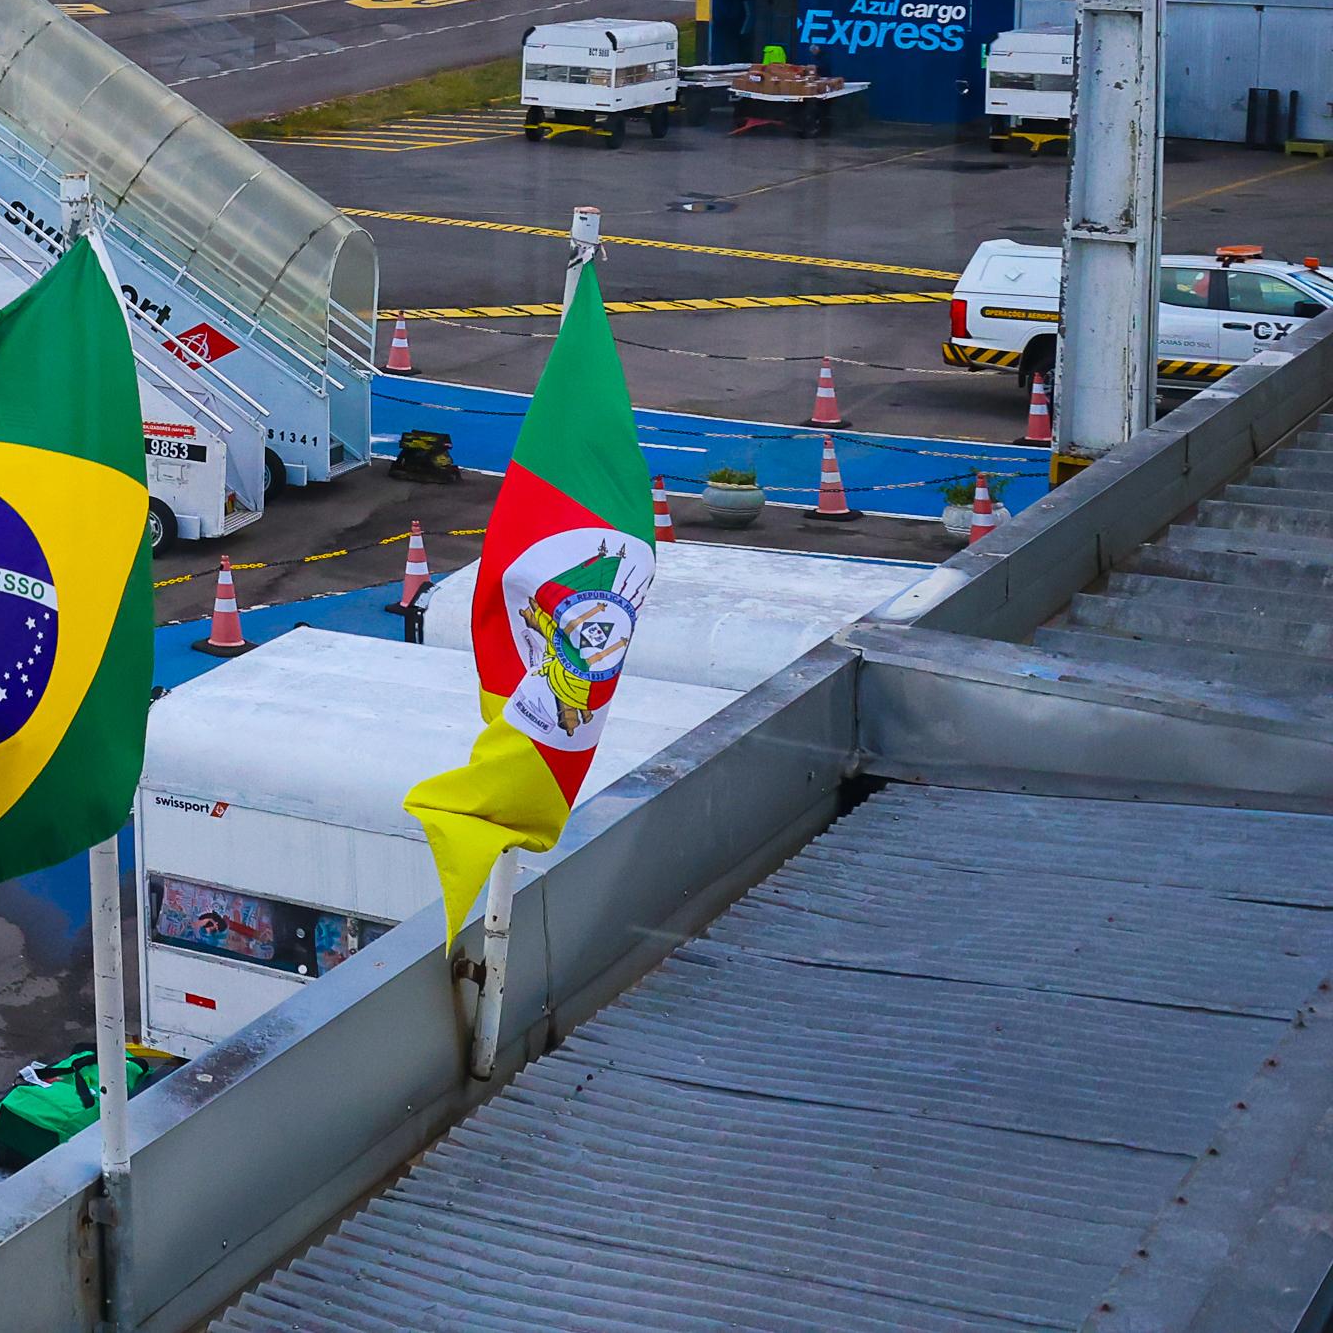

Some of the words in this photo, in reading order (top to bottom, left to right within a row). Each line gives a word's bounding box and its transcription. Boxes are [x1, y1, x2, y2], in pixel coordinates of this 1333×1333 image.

[900, 2, 966, 24] cargo
[800, 9, 965, 54] Express
[1253, 321, 1293, 341] CX
[150, 439, 189, 460] 9853
[155, 795, 210, 814] swissport
